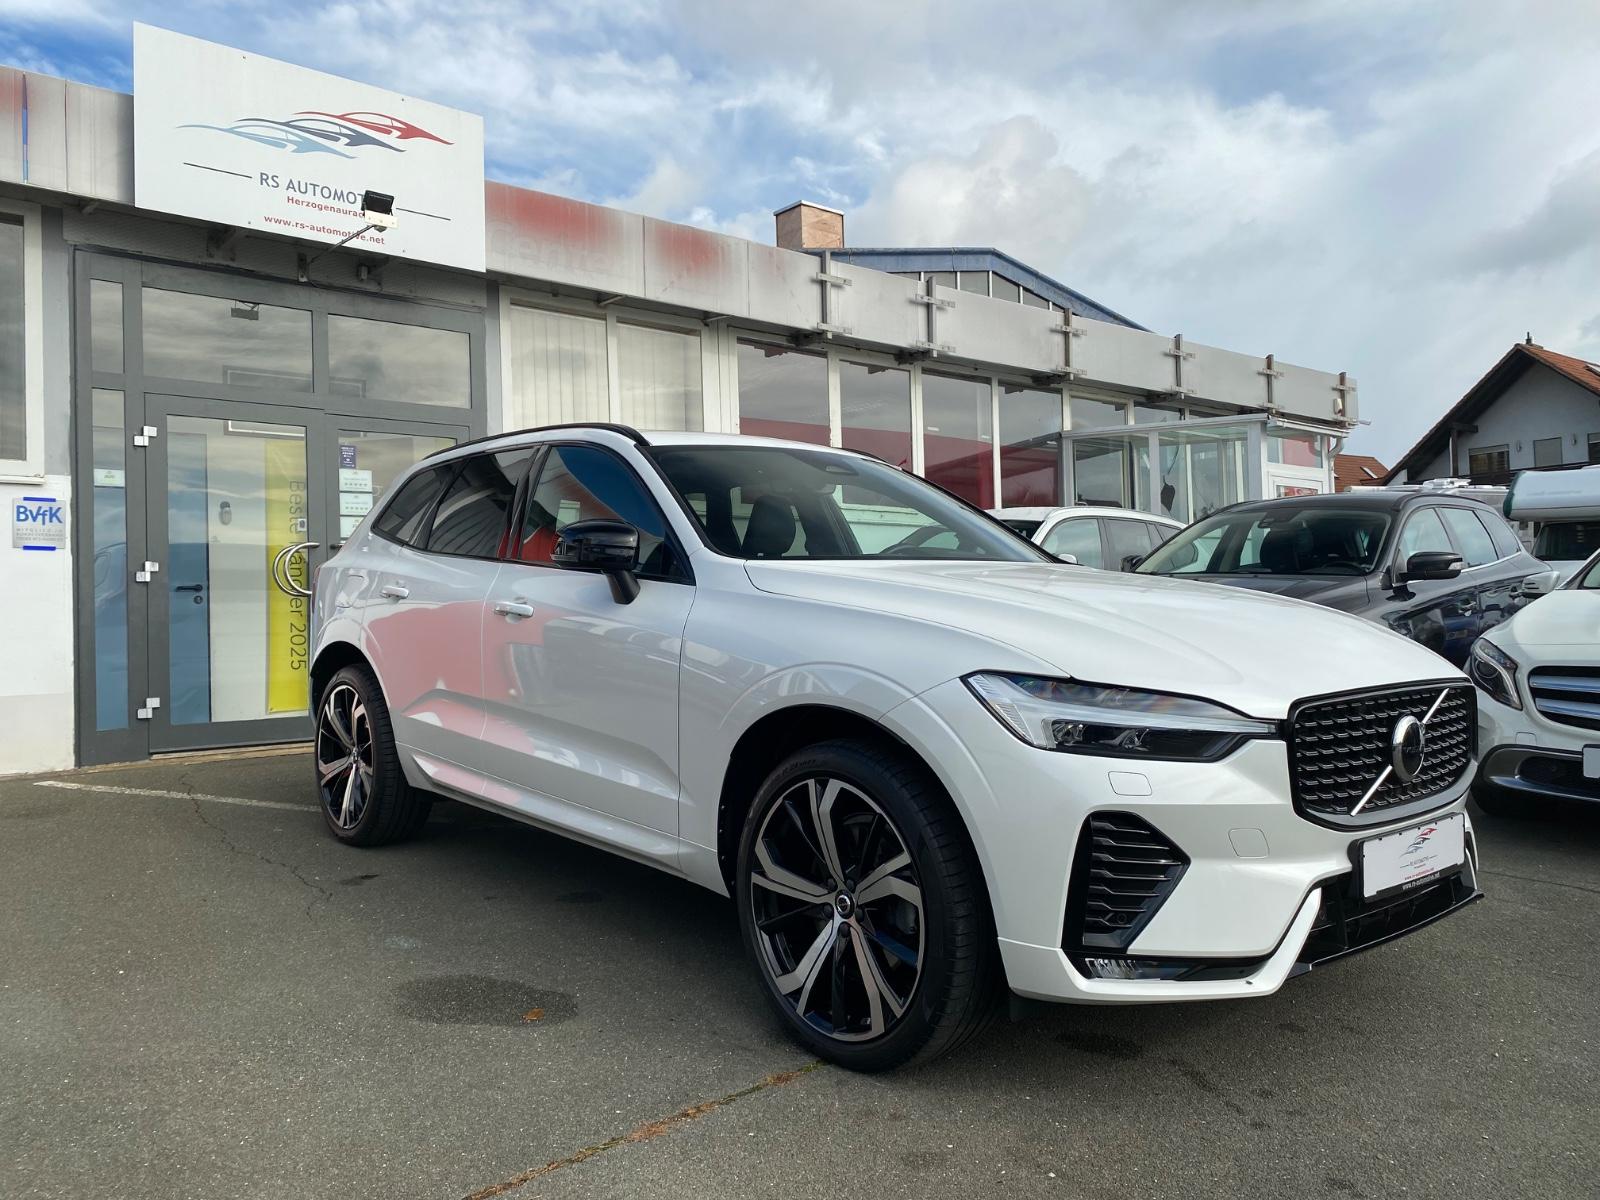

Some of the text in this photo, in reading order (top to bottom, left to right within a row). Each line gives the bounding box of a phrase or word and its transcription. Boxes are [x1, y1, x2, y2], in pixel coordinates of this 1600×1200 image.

[260, 172, 364, 205] RS AUTOMOT
[287, 195, 365, 219] Herzogenaurac
[290, 622, 307, 671] 2025
